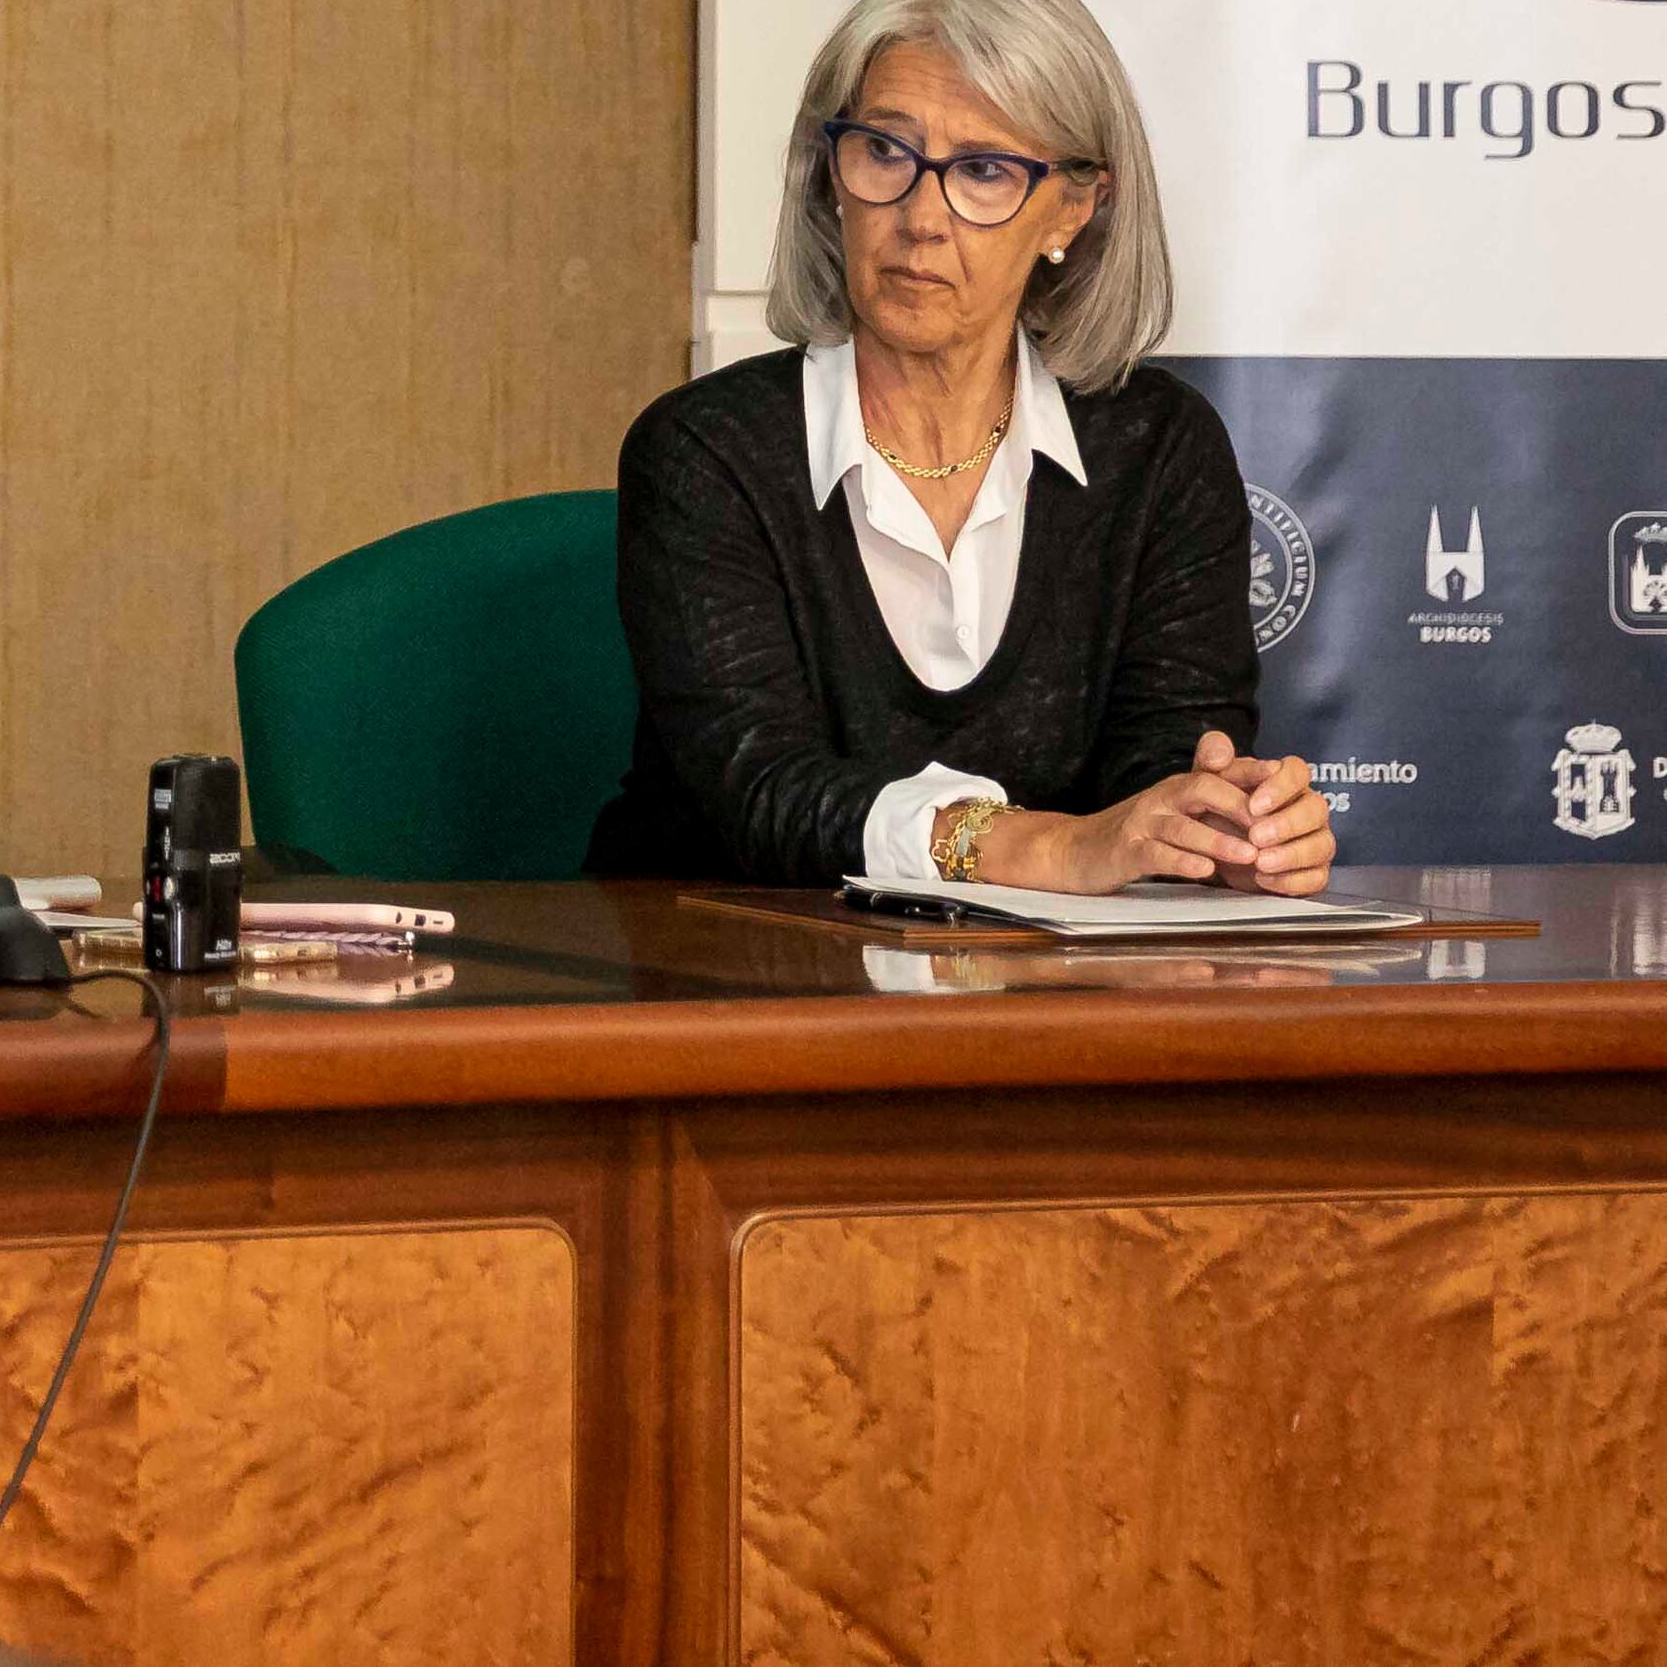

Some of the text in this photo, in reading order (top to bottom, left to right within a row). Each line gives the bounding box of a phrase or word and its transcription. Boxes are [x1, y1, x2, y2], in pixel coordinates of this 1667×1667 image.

[1306, 60, 1666, 161] Burgos
[1419, 626, 1492, 643] BURGOS
[1307, 756, 1418, 784] amiento
